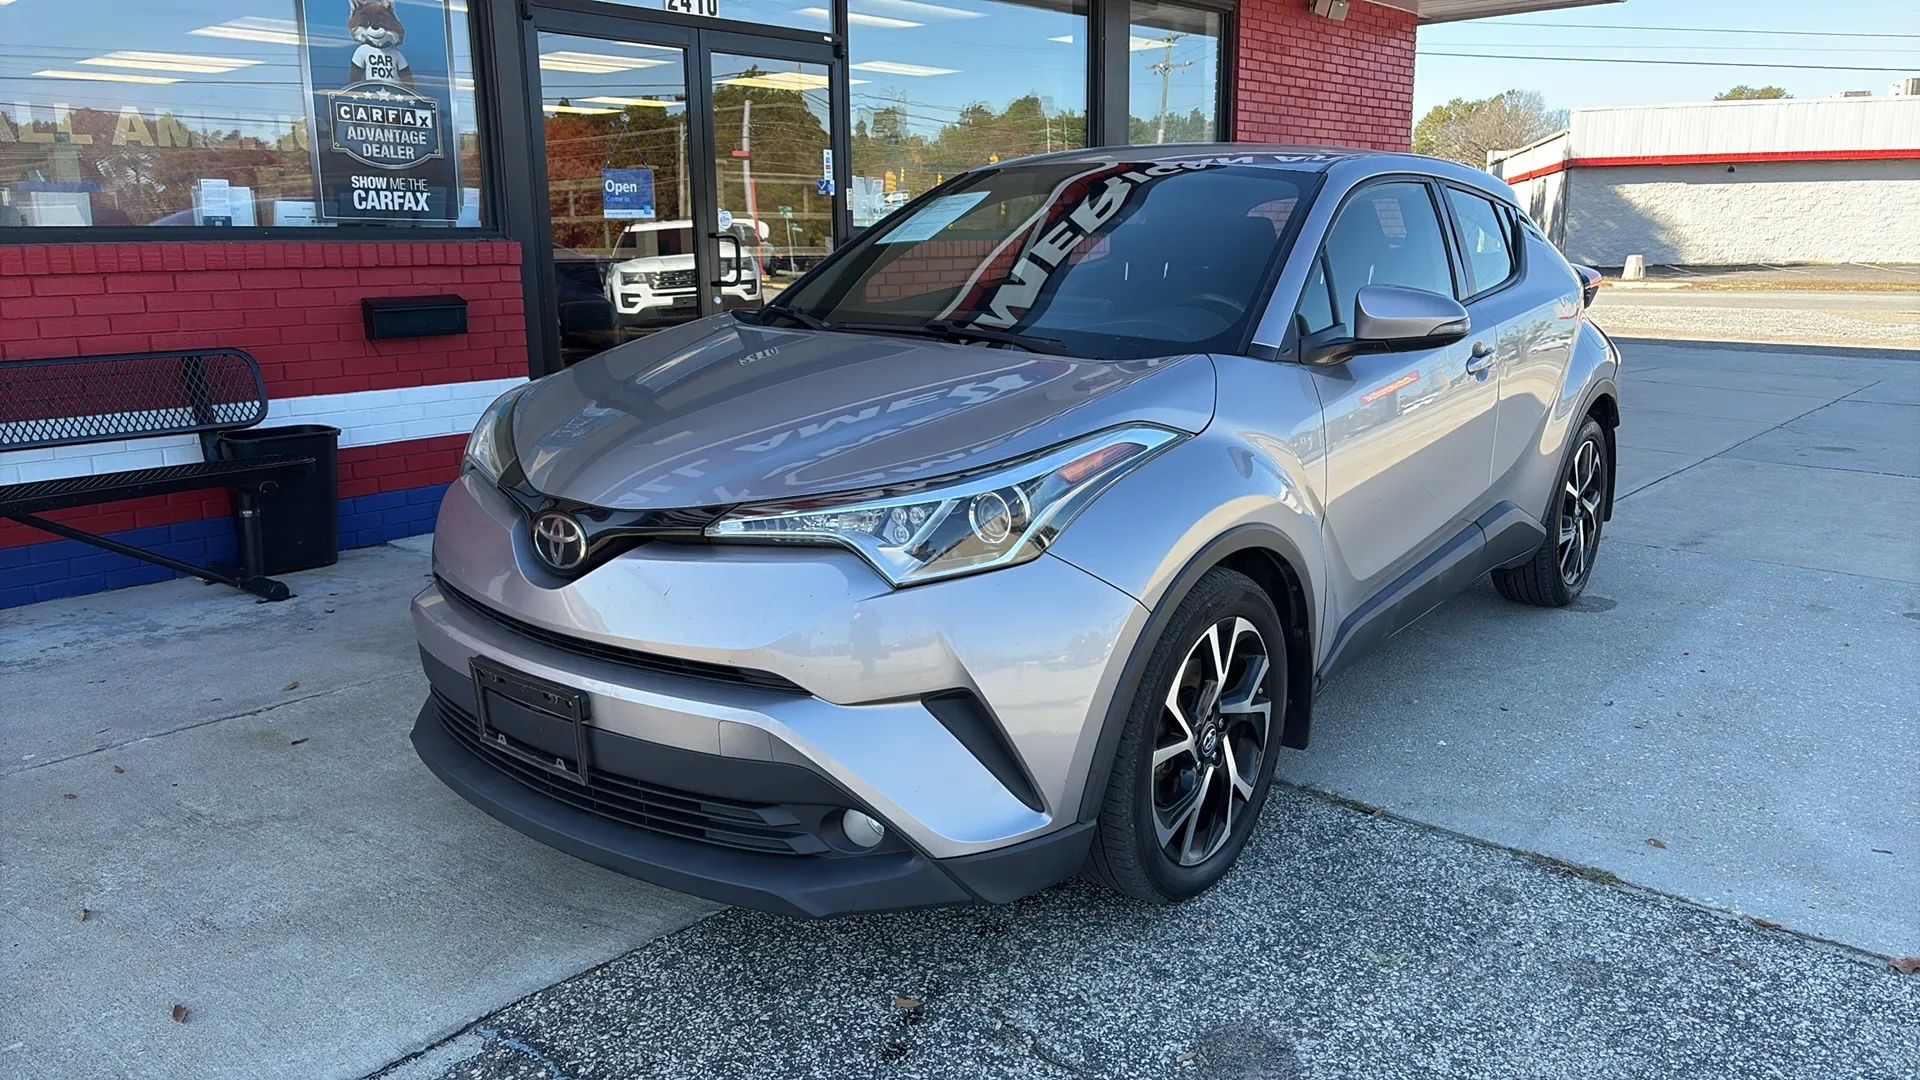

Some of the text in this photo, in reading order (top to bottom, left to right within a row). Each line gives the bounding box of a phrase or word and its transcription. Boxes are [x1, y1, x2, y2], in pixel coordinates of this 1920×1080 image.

[668, 0, 717, 16] 2410
[368, 54, 393, 67] CAR
[371, 67, 394, 78] FOX
[339, 106, 430, 128] CARFAX
[347, 126, 427, 145] ADVANTAGE
[362, 143, 415, 160] DEALER
[351, 175, 428, 191] SHOW ME THE
[605, 179, 637, 195] Open
[353, 189, 430, 212] CARFAX
